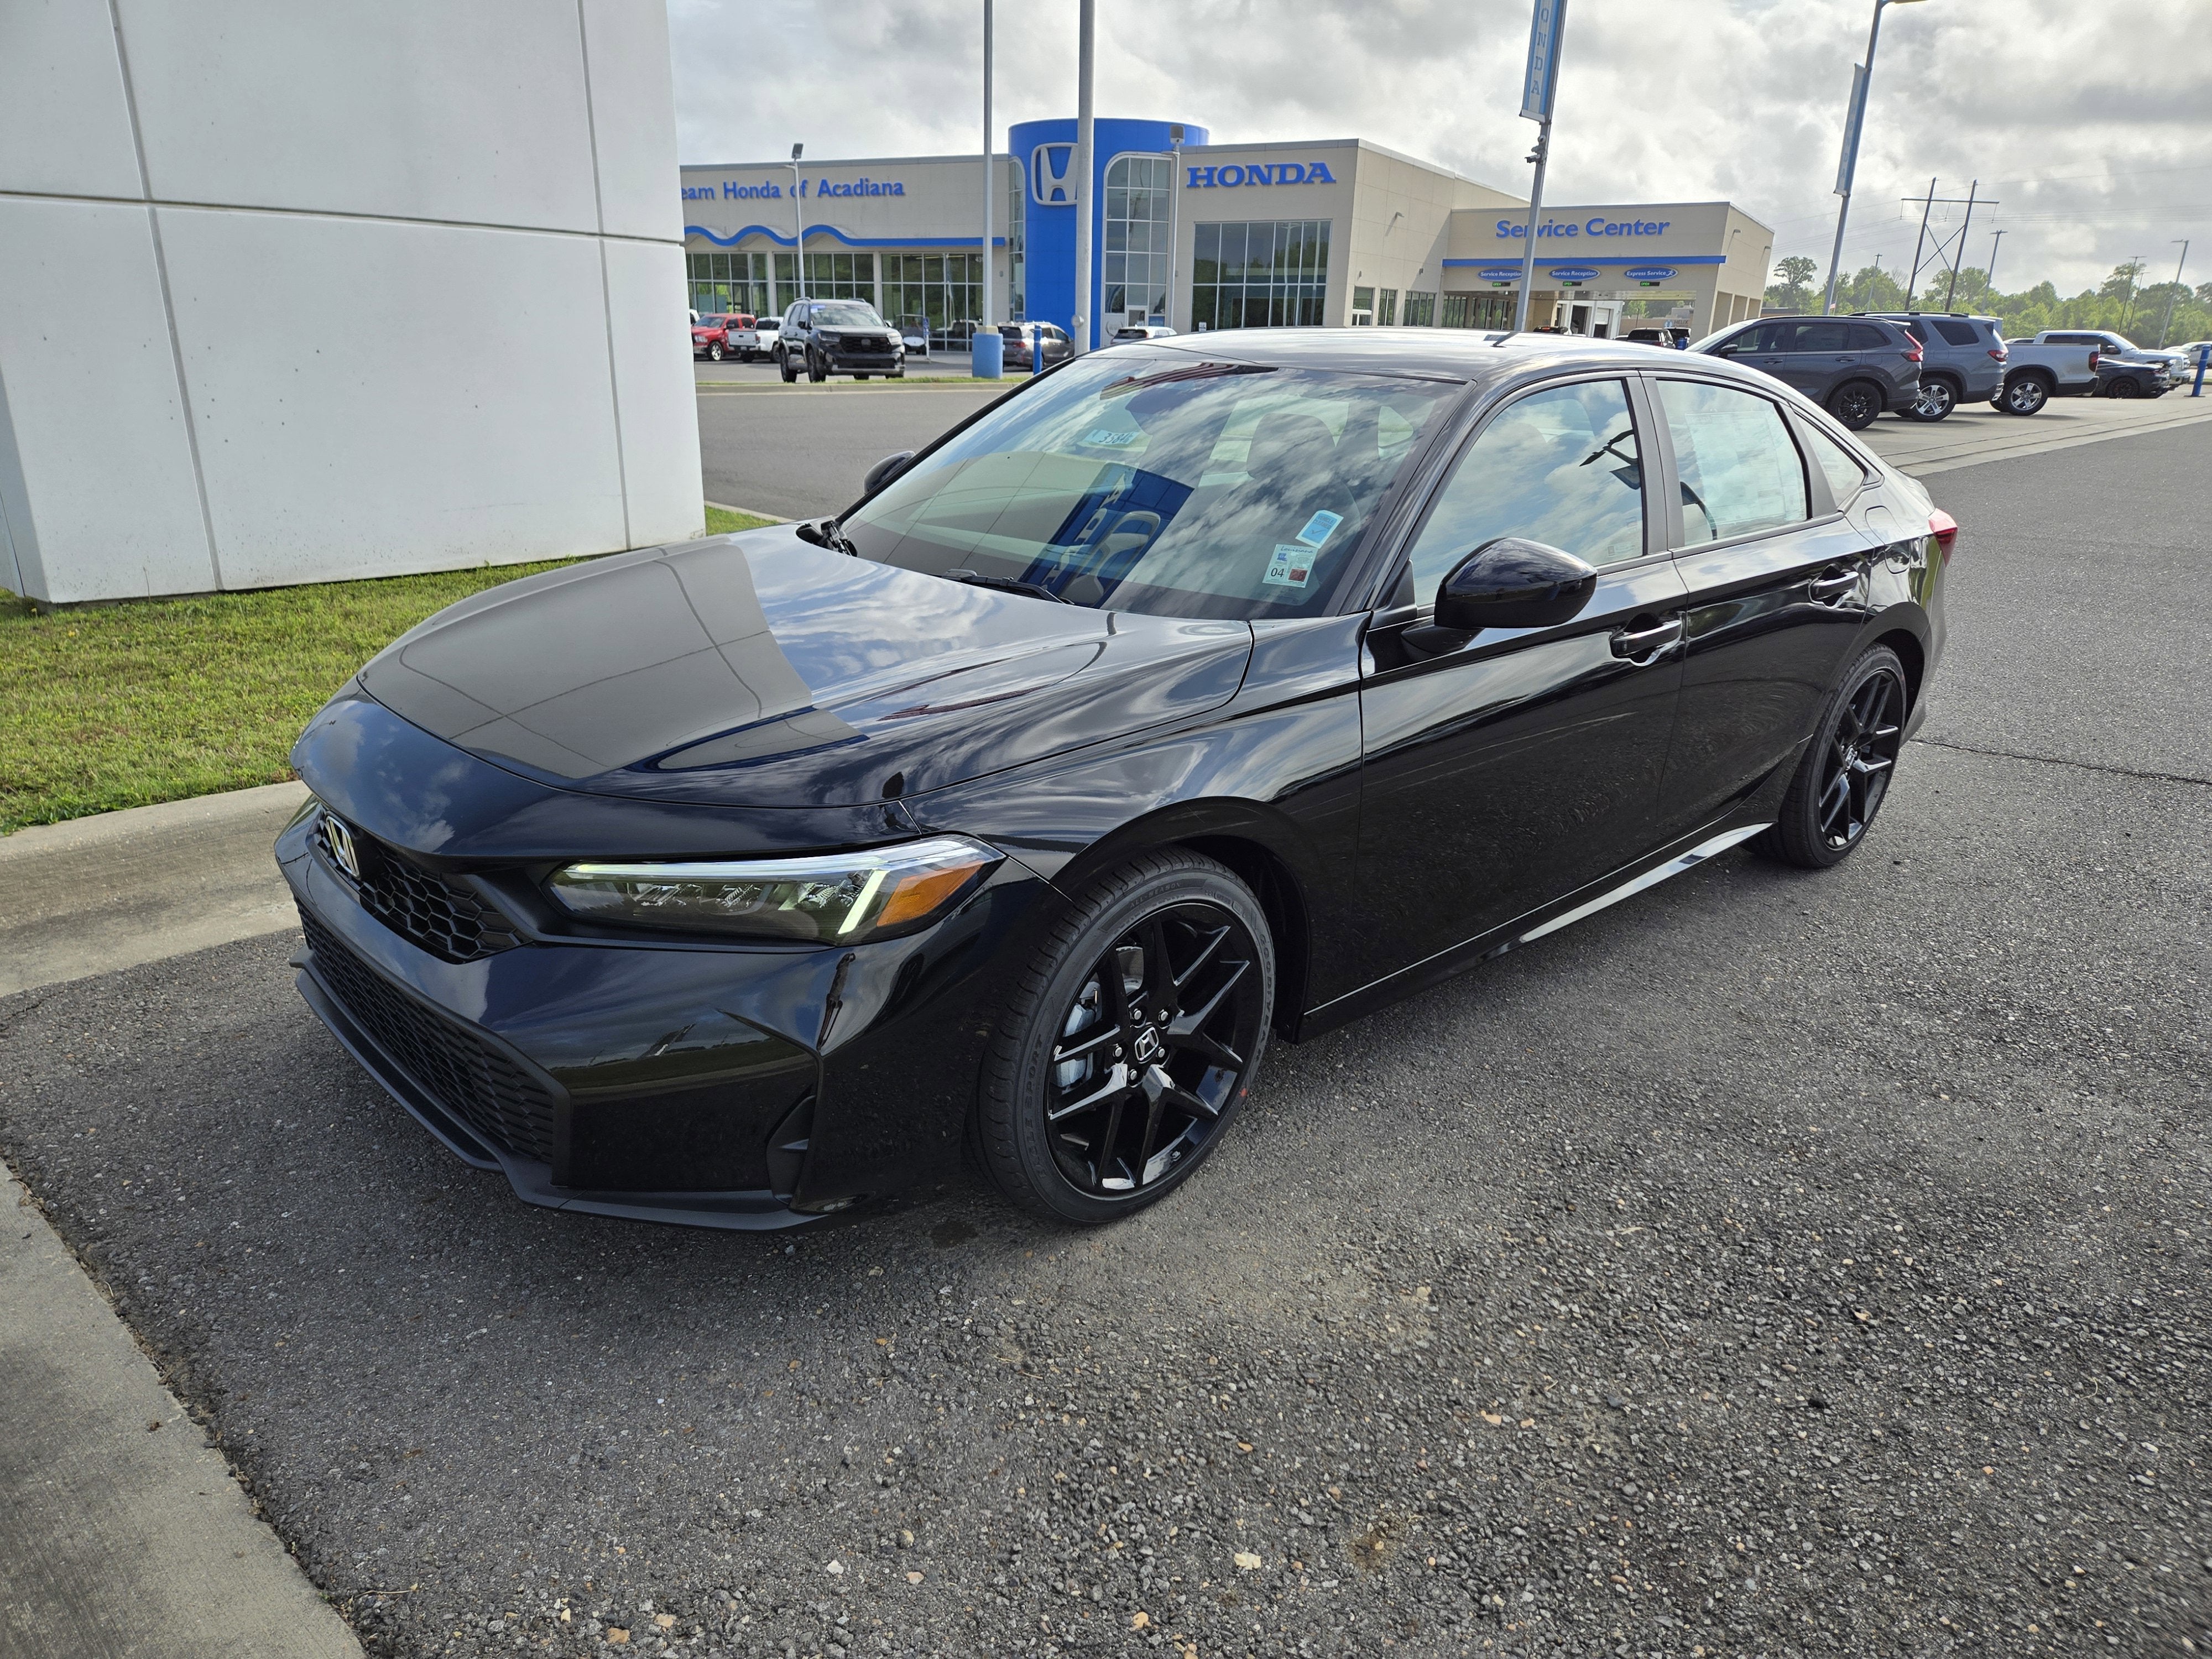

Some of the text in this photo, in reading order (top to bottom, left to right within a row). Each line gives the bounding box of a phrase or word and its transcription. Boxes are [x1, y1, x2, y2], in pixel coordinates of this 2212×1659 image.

[1186, 162, 1337, 189] HONDA
[723, 180, 781, 200] Honda
[817, 178, 906, 198] Acadiana
[1585, 217, 1671, 236] Center
[1280, 545, 1313, 554] Louisiana
[1270, 567, 1285, 577] 04
[1025, 1033, 1042, 1109] SPORT
